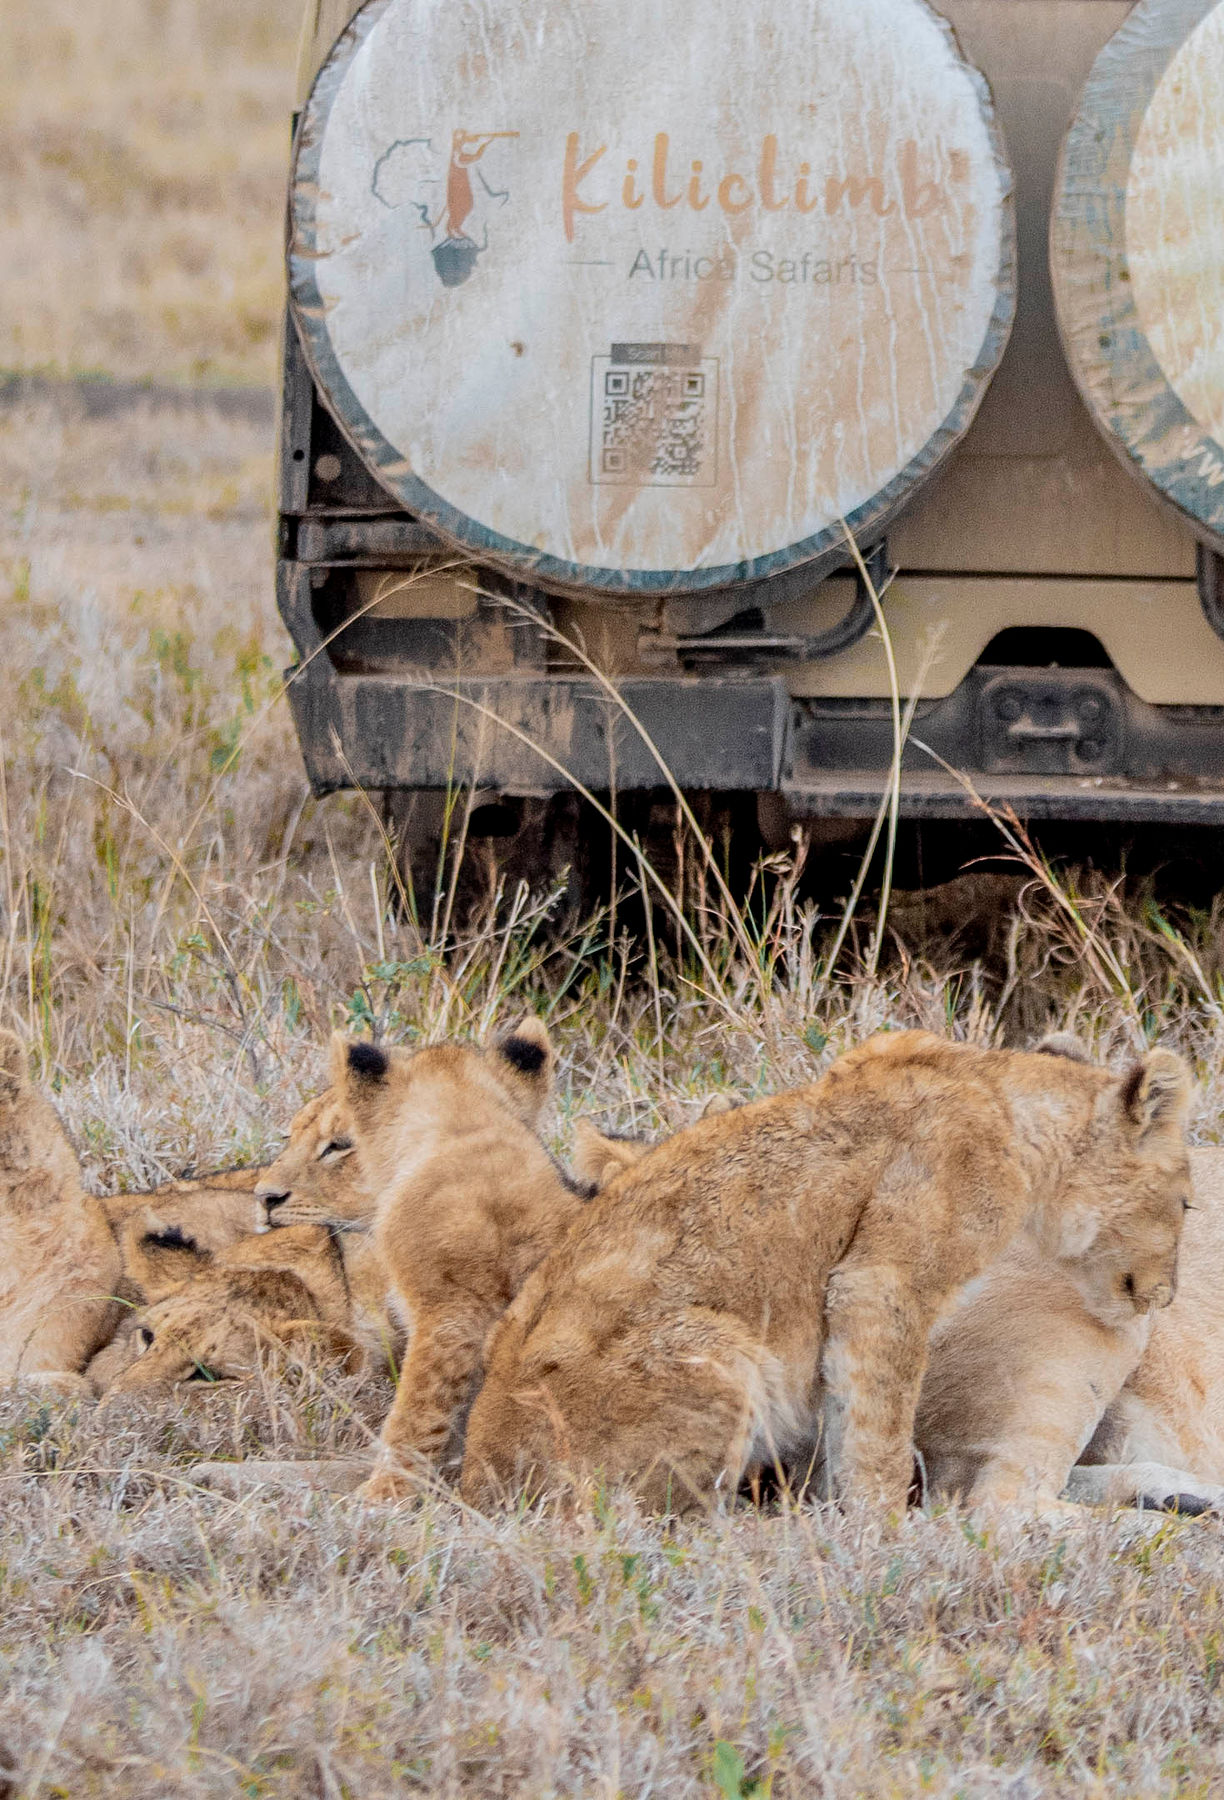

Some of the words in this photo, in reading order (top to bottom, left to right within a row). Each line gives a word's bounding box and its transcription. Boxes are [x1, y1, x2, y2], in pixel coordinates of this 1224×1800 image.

[562, 132, 948, 244] Kiliclimb
[628, 249, 736, 281] Africa
[750, 250, 879, 287] Safaris
